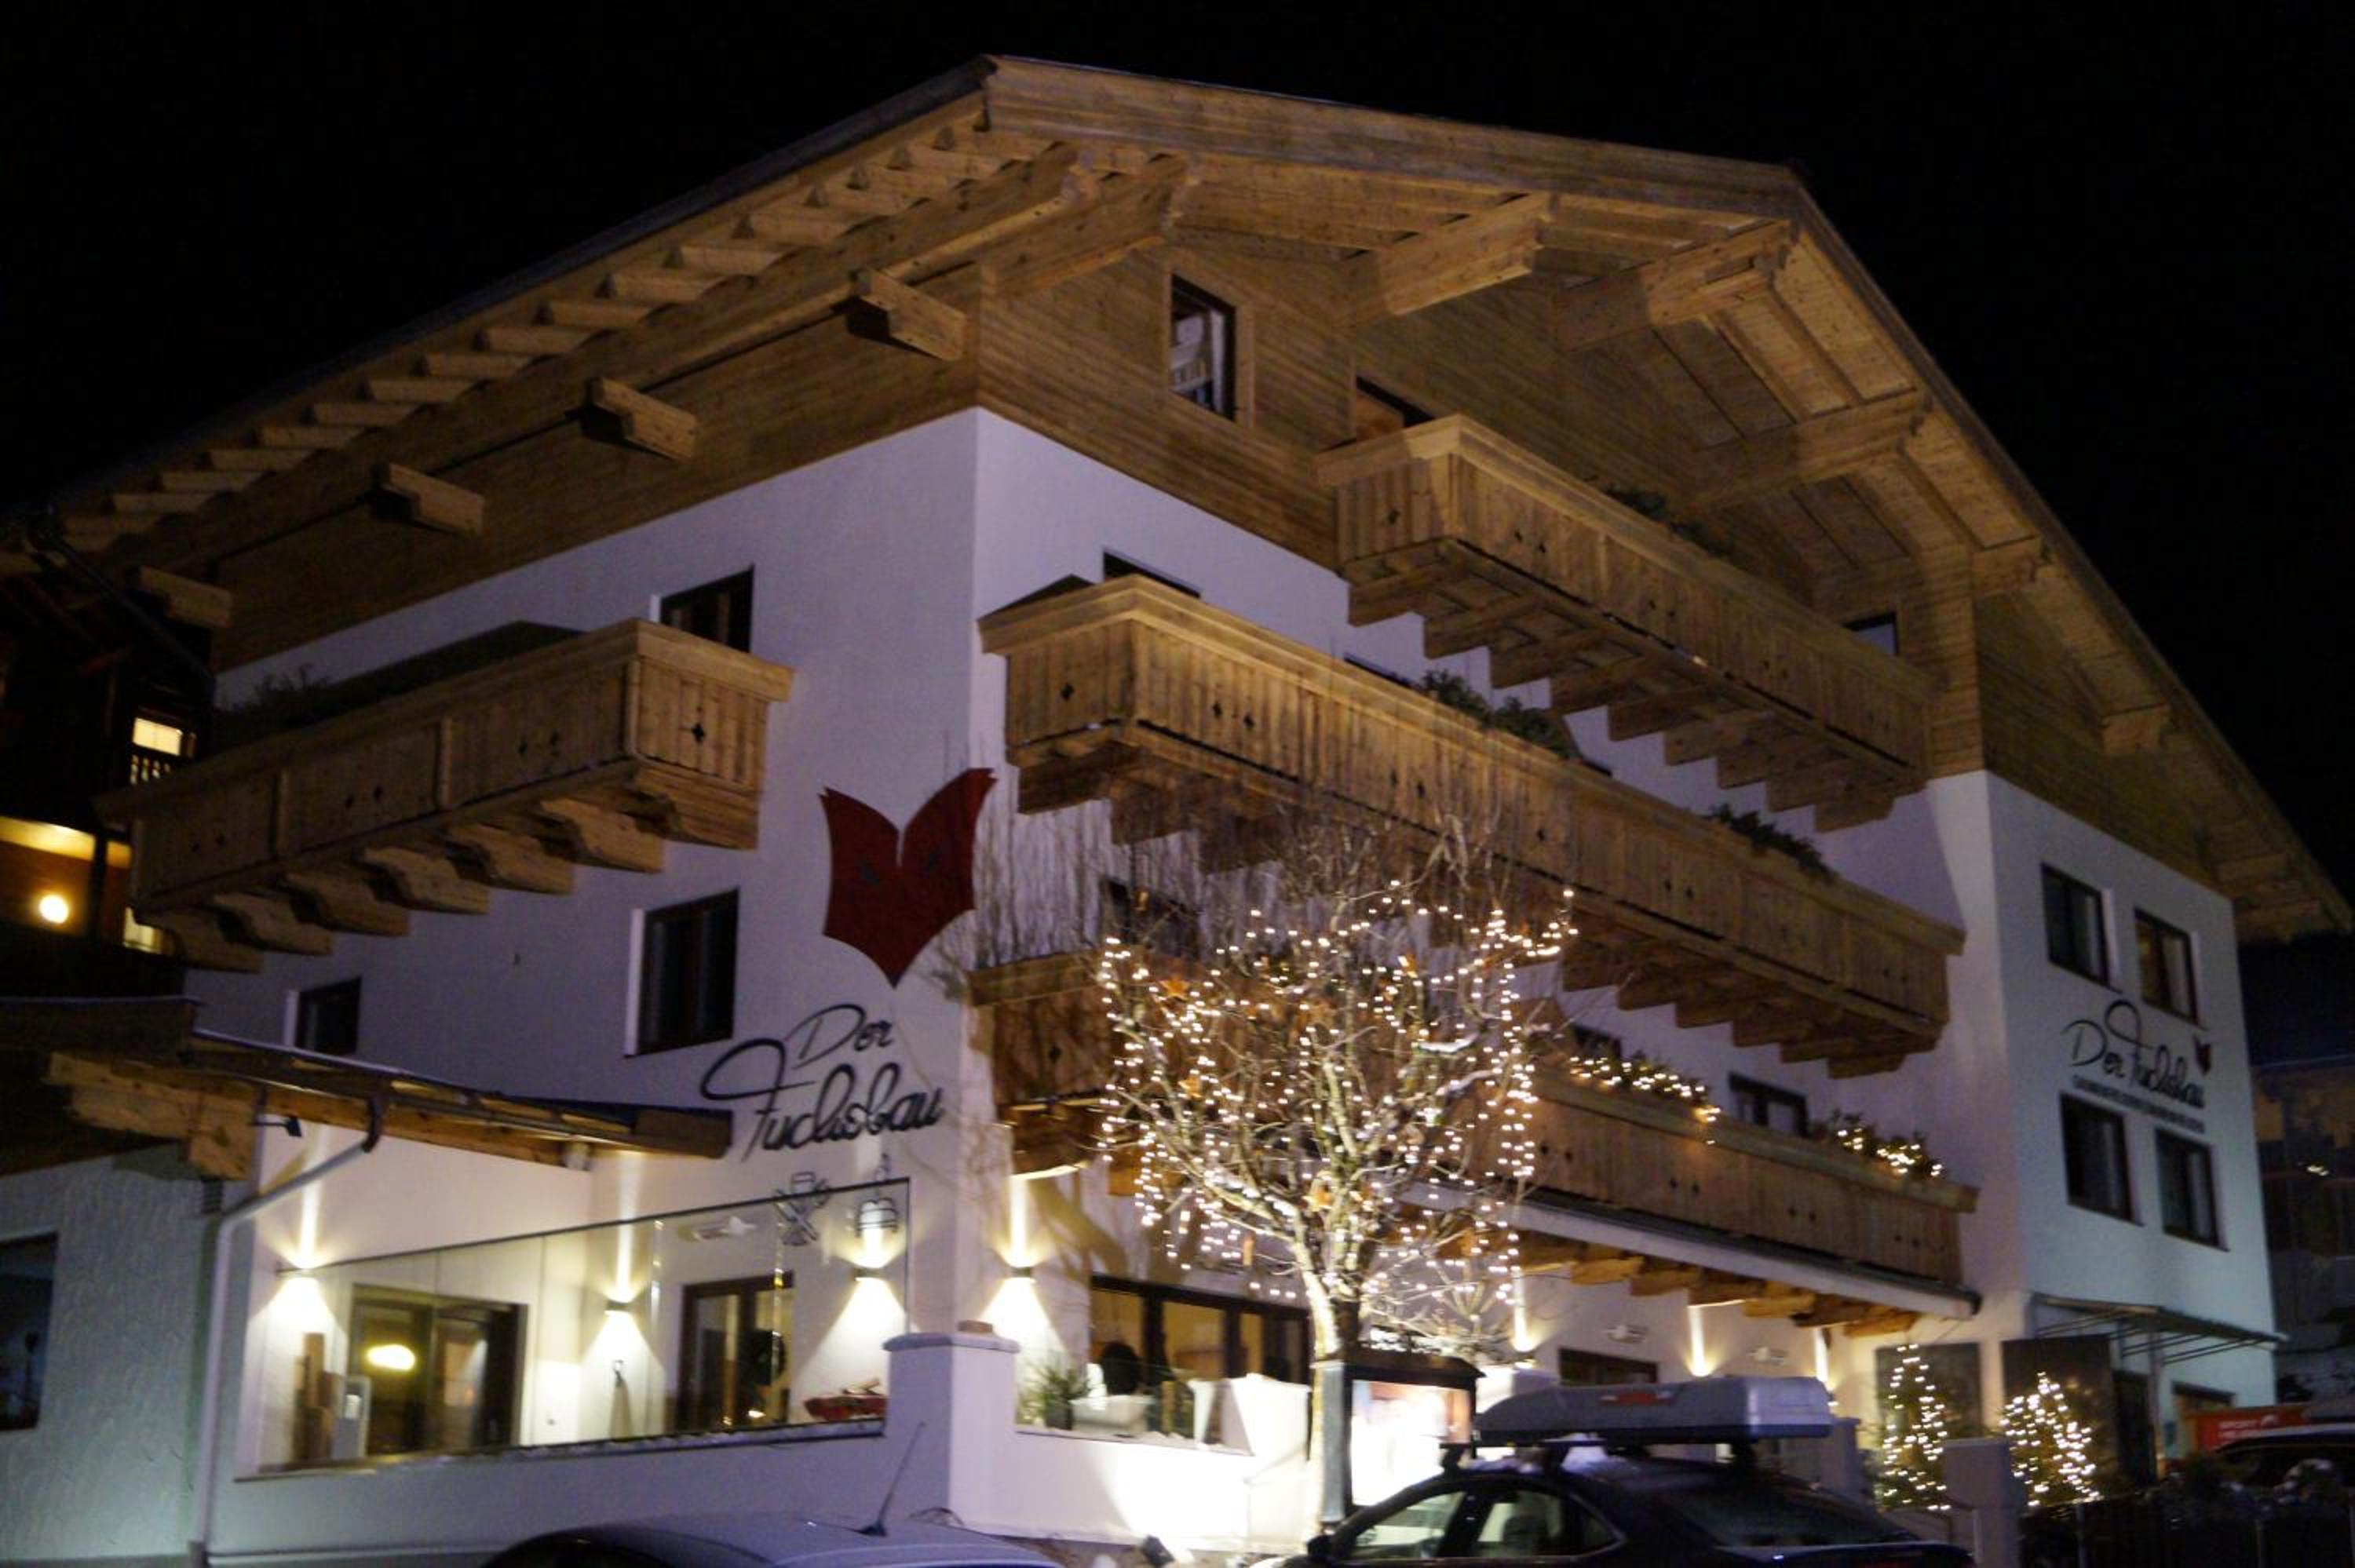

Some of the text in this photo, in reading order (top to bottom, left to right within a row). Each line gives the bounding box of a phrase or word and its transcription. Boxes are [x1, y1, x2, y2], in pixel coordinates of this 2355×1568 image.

[786, 1004, 893, 1070] Der
[2060, 1019, 2126, 1079] Der
[699, 1037, 944, 1162] Fuchsbau
